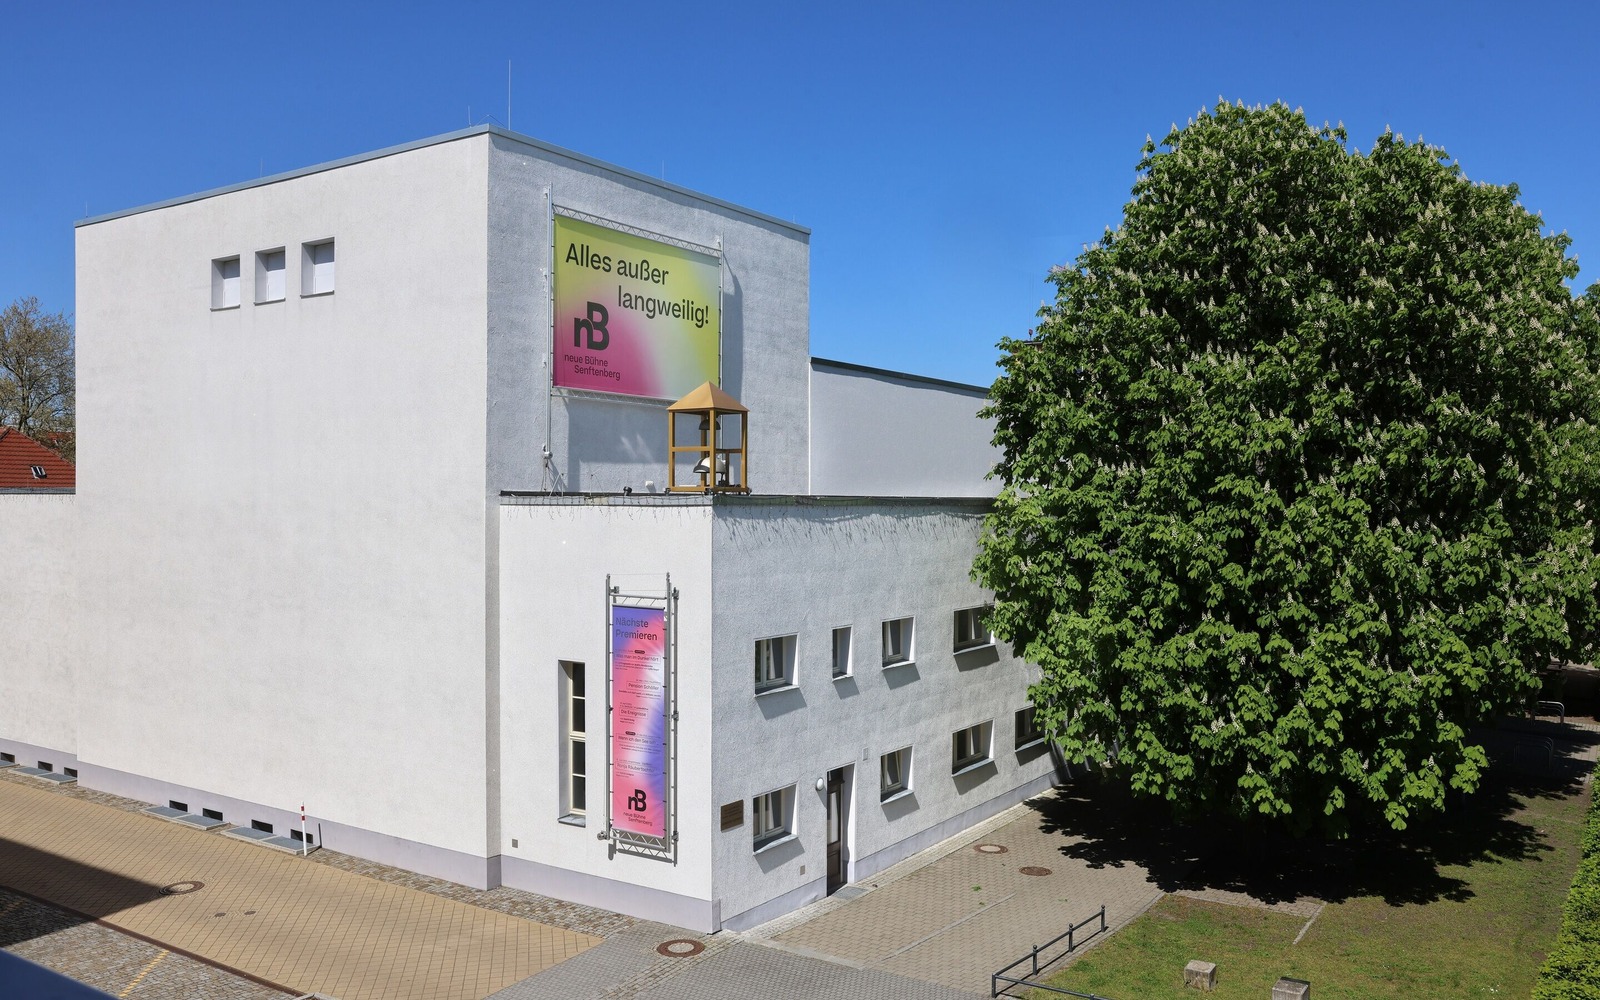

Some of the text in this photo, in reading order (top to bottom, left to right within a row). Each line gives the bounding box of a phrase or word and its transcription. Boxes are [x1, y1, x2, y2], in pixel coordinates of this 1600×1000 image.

[565, 243, 669, 285] Alles außer
[618, 285, 709, 329] langweilig!
[574, 301, 610, 351] nB
[564, 354, 609, 367] neue Bühne
[574, 365, 621, 381] Senftenberg
[615, 617, 649, 628] Nächste
[615, 629, 658, 641] Premieren
[628, 789, 647, 812] nB
[628, 816, 653, 827] Senftenberg
